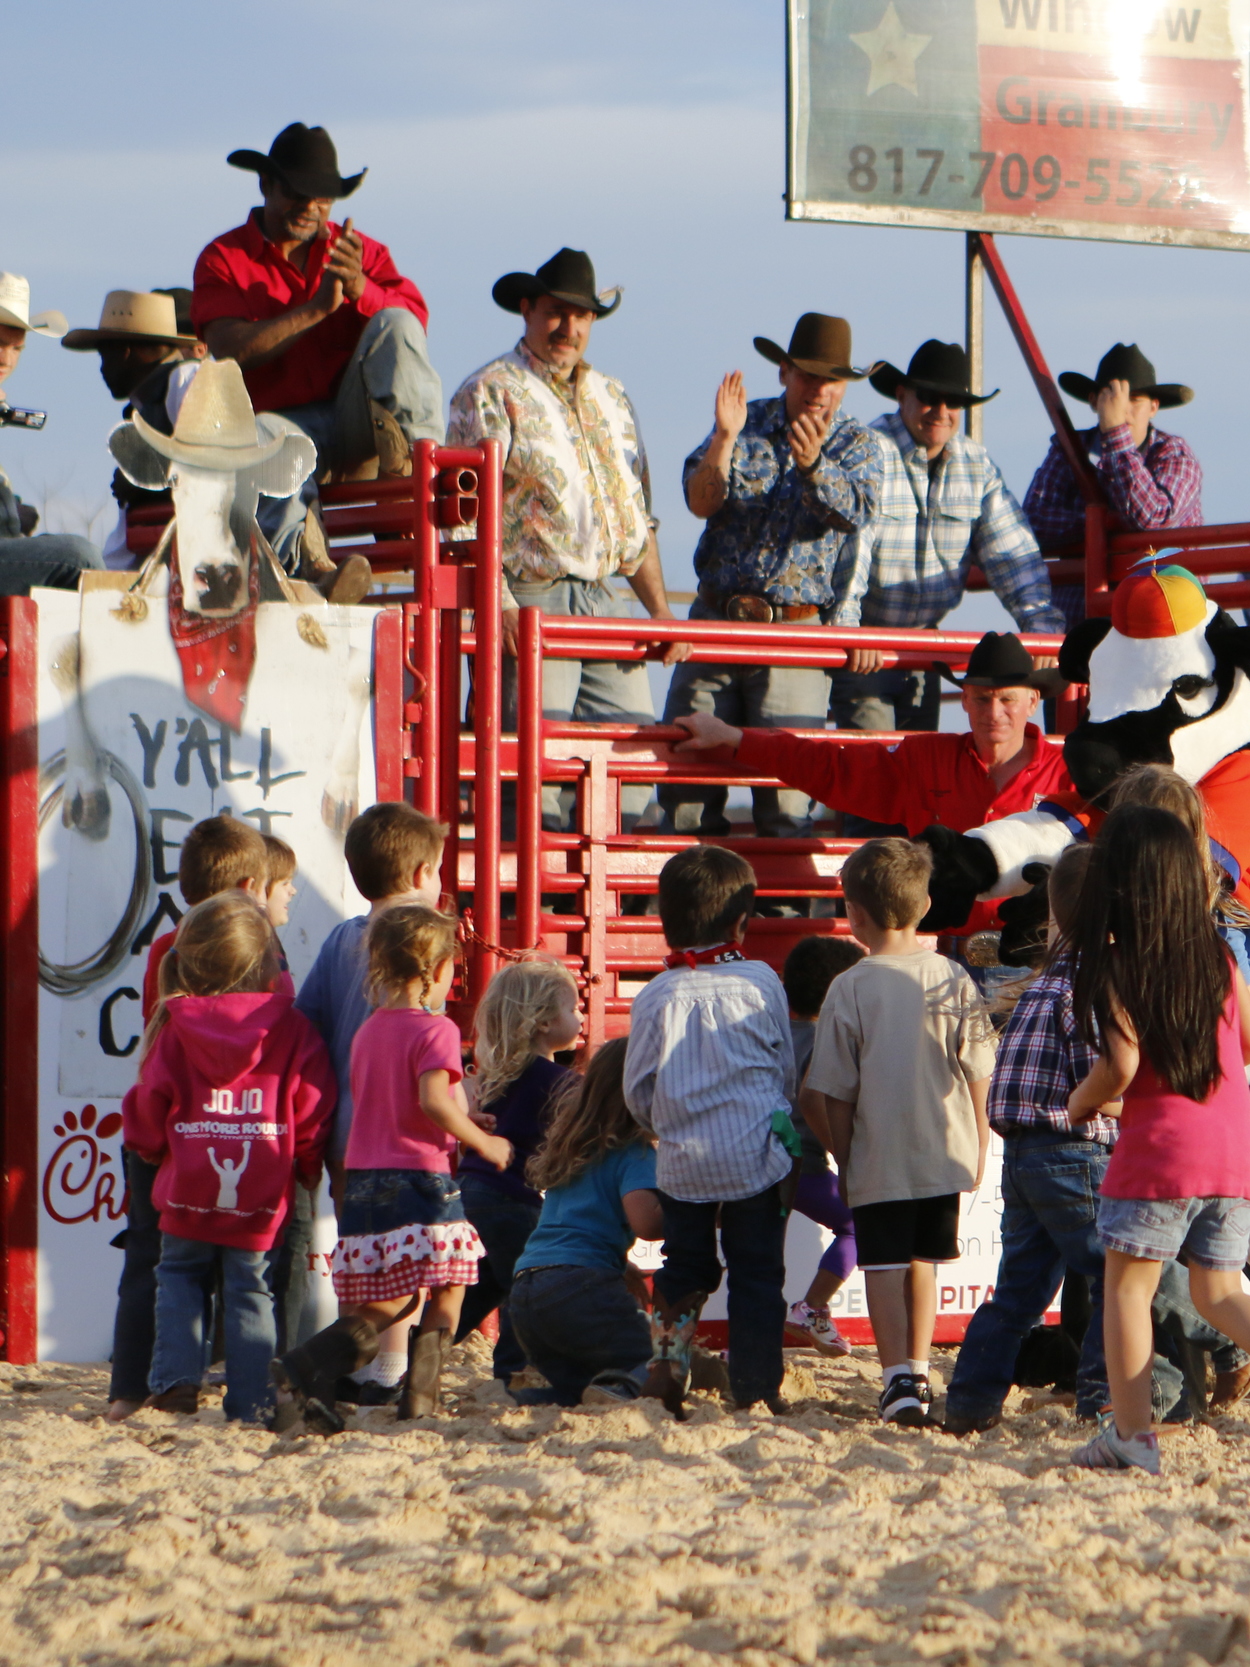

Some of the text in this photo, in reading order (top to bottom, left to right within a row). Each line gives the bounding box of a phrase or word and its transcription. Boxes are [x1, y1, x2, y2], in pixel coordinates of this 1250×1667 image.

[129, 713, 307, 800] Y'ALL
[203, 1088, 263, 1116] JOJO
[201, 1120, 240, 1135] MORE
